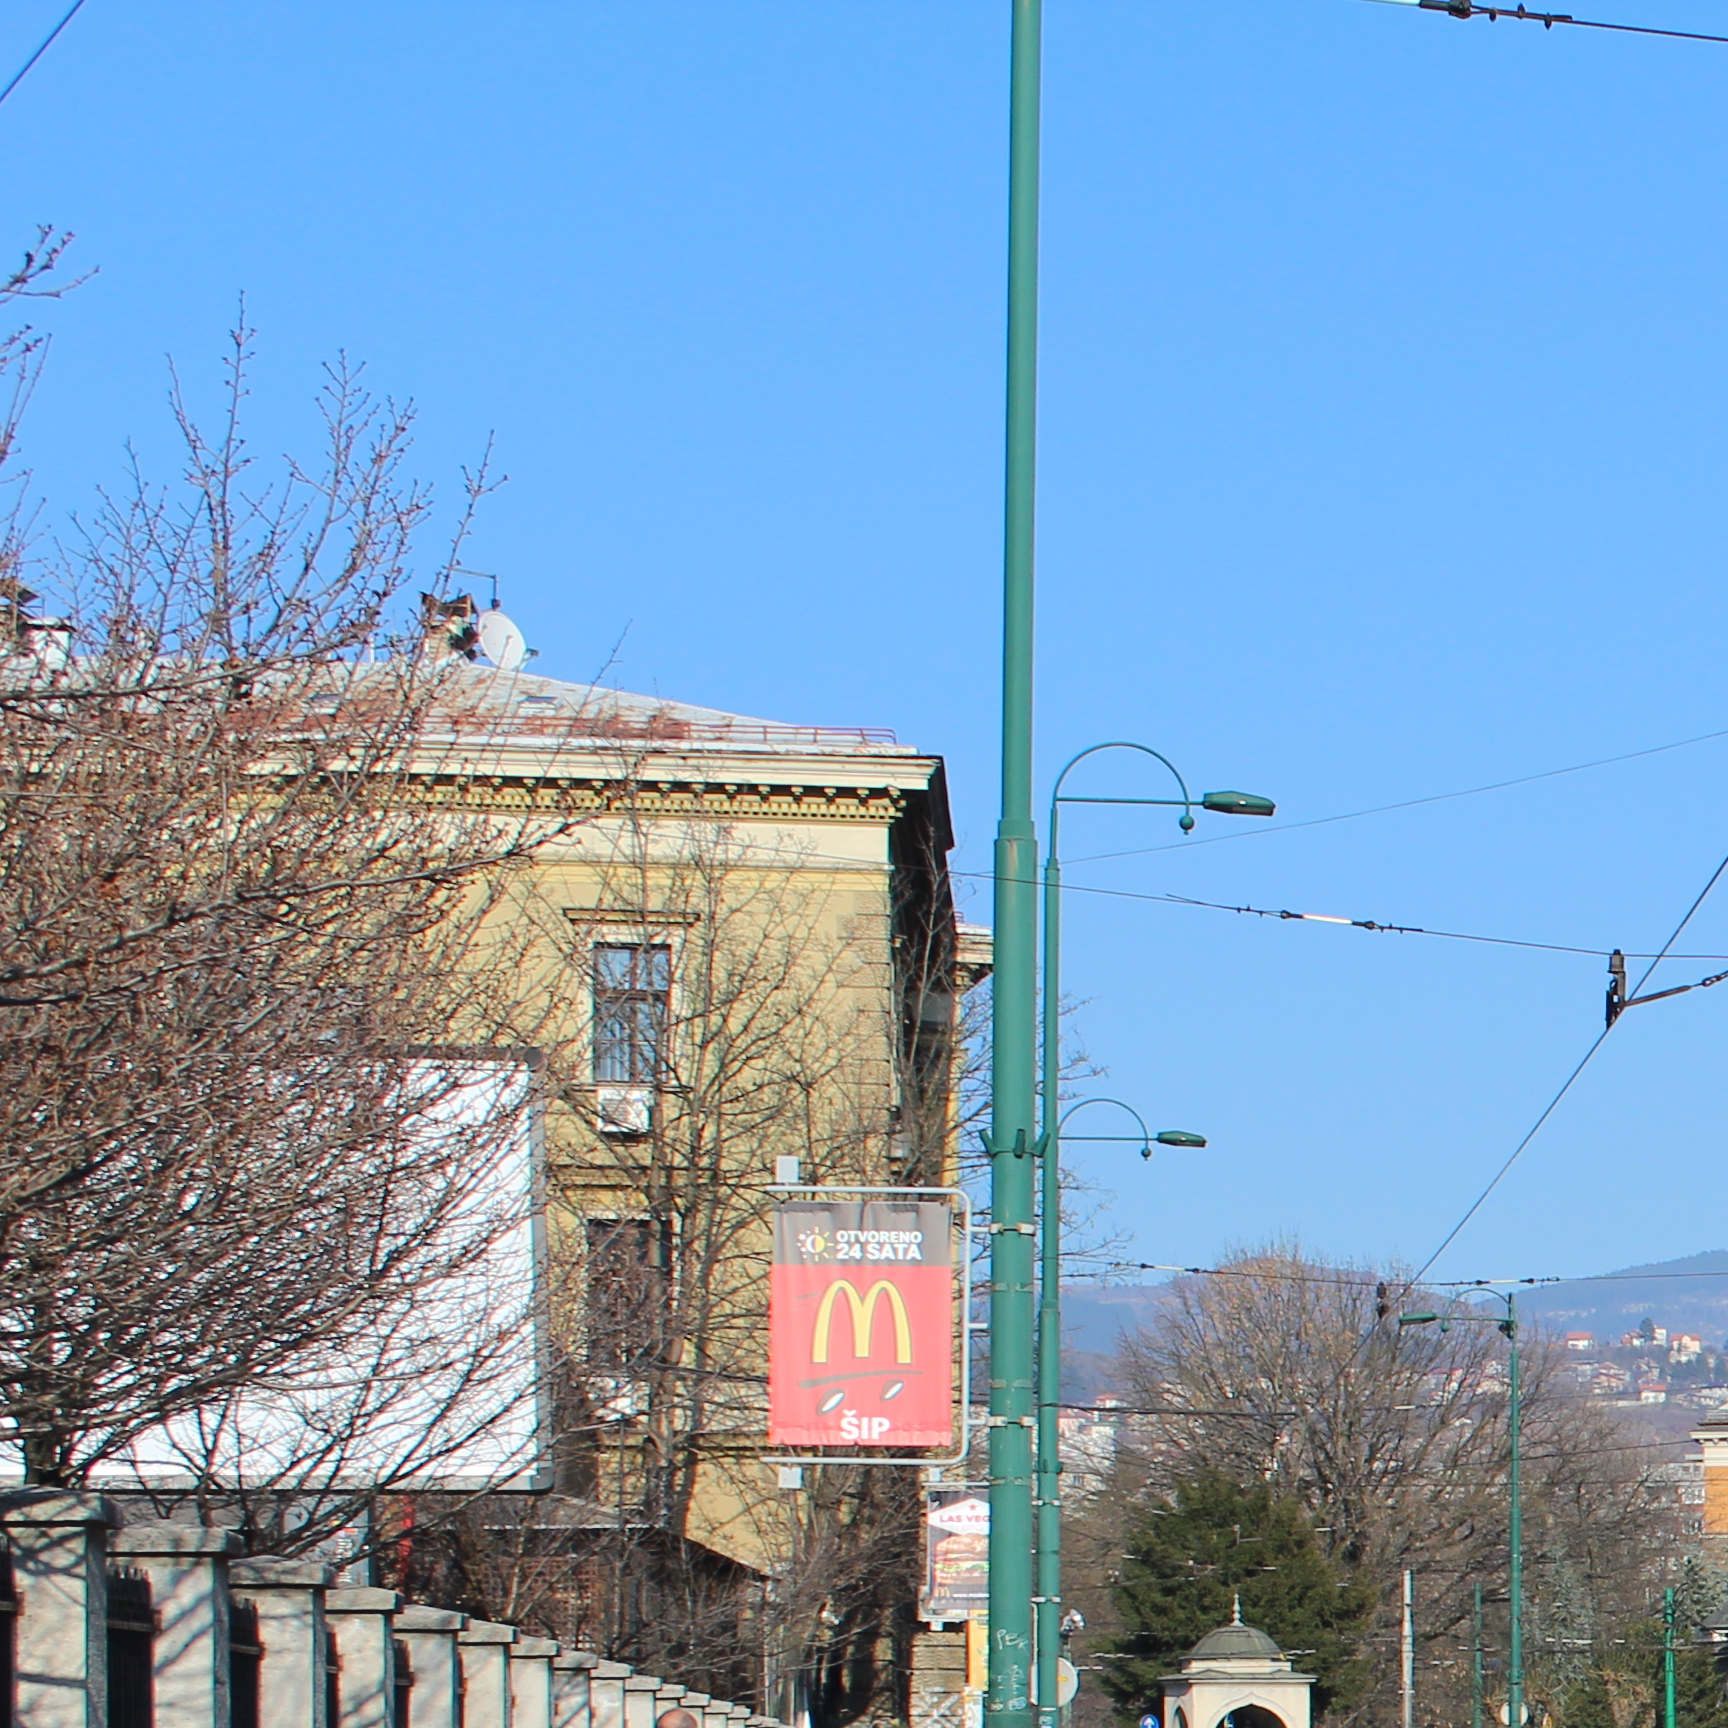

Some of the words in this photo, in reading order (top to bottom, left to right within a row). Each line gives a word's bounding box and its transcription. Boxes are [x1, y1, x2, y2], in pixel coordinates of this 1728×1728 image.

[836, 1230, 923, 1243] OTVORENO
[836, 1244, 863, 1260] 24
[866, 1244, 922, 1260] SATA
[839, 1409, 890, 1440] ŠIP
[940, 1515, 963, 1523] LAS
